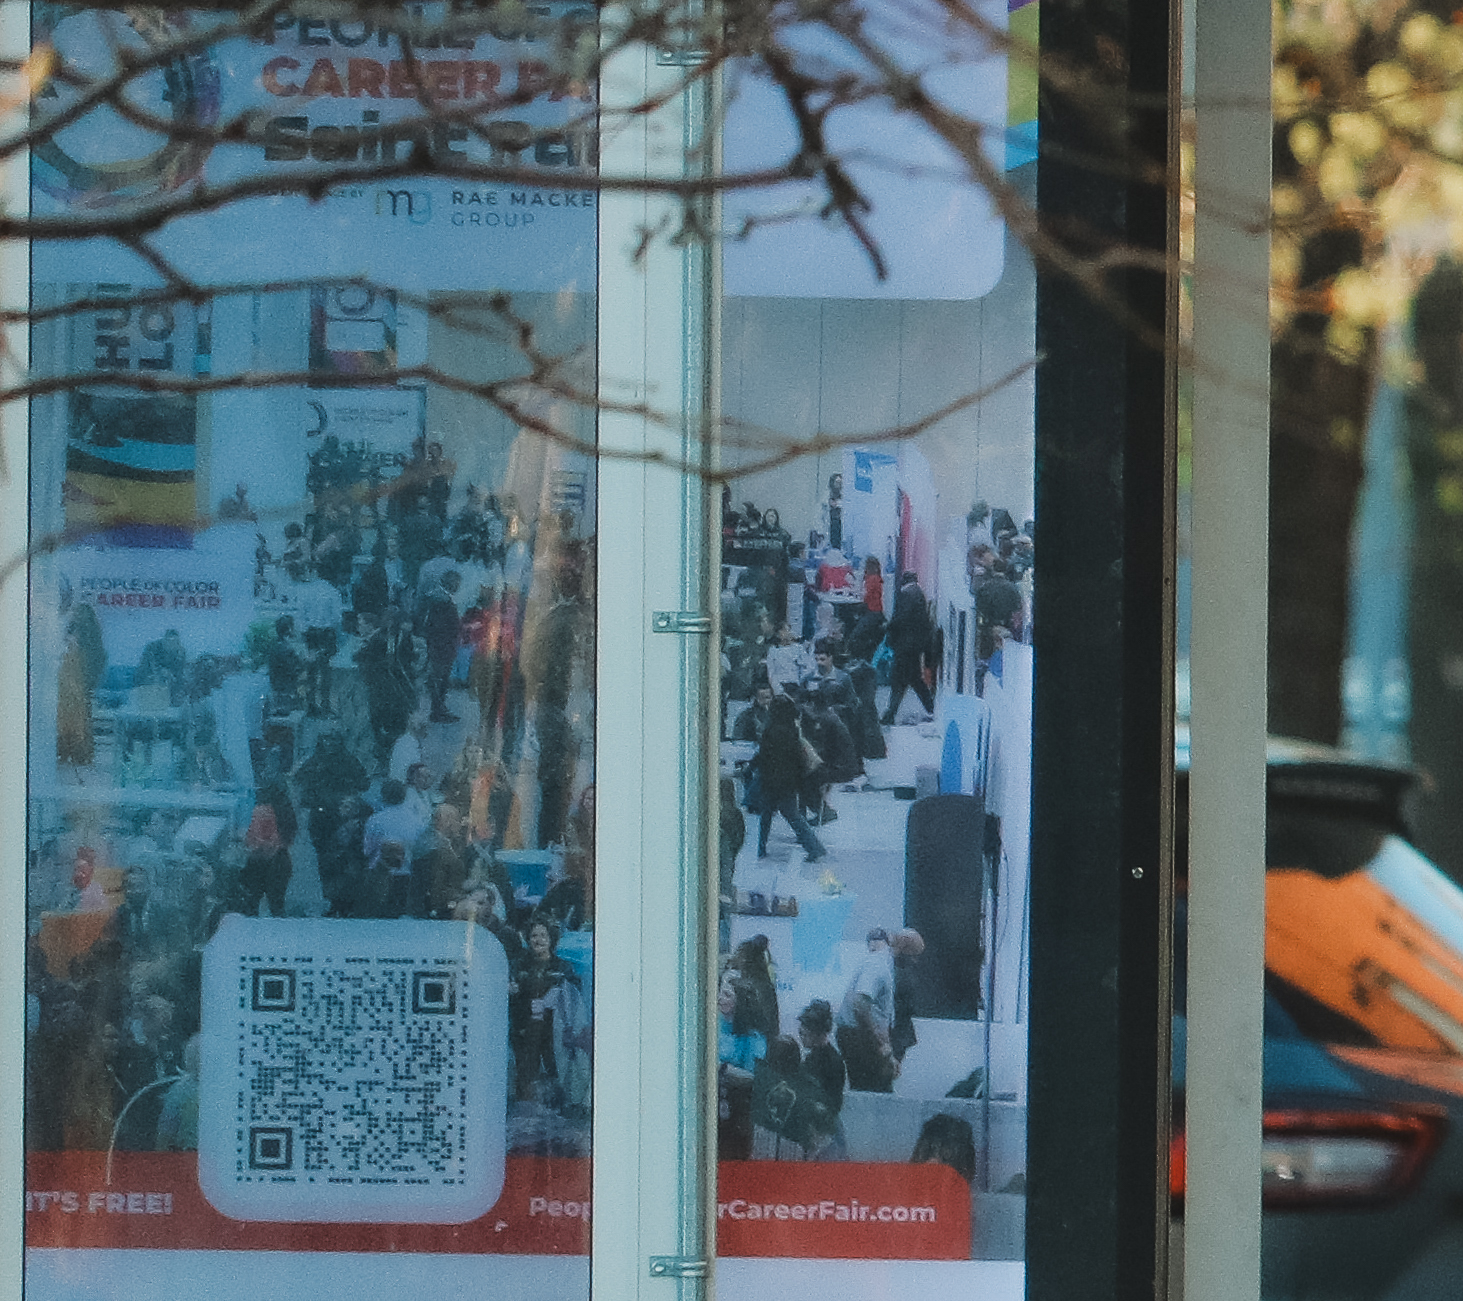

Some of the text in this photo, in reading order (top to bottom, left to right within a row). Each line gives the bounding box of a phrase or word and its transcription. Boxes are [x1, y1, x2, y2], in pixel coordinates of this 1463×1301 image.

[262, 56, 502, 98] CAREER
[451, 190, 498, 206] RAE
[450, 212, 535, 227] GROUP
[87, 1192, 172, 1214] FREE!
